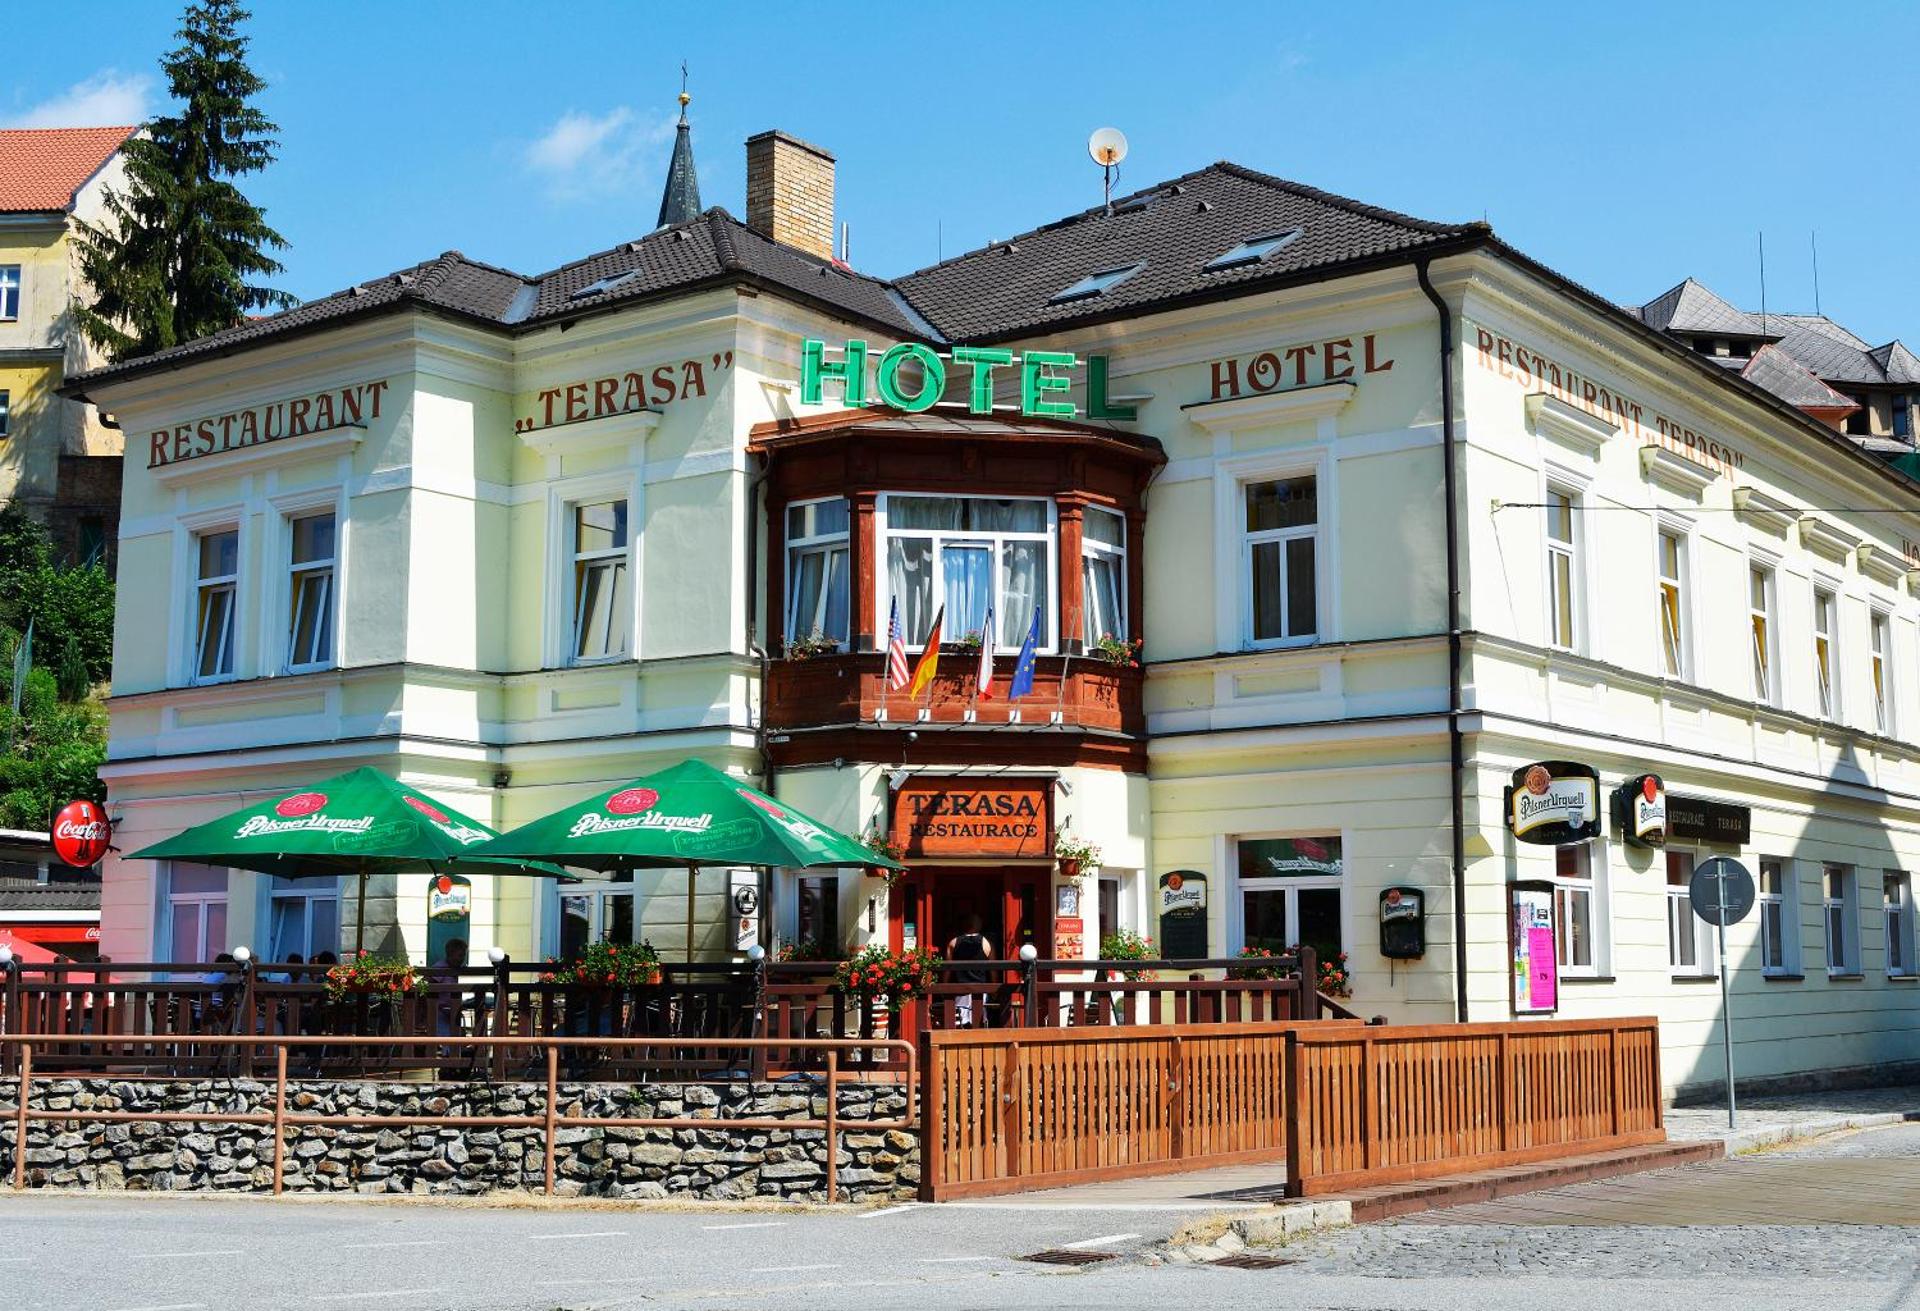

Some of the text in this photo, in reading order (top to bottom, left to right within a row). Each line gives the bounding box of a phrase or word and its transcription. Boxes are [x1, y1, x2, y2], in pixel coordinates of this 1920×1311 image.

[800, 339, 1138, 421] HOTEL
[1210, 334, 1394, 399] HOTEL
[1477, 328, 1643, 439] RESTAURANT
[149, 380, 389, 467] RESTAURANT
[907, 793, 1038, 816] TERASA
[1521, 792, 1584, 820] Pilsner Urquell
[57, 820, 107, 840] Coca-Cola
[233, 815, 311, 839] Pilsner
[308, 812, 375, 833] Urquell
[567, 812, 645, 838] Pilsner
[641, 810, 713, 833] Urquell
[909, 823, 1038, 838] RESTAURACE
